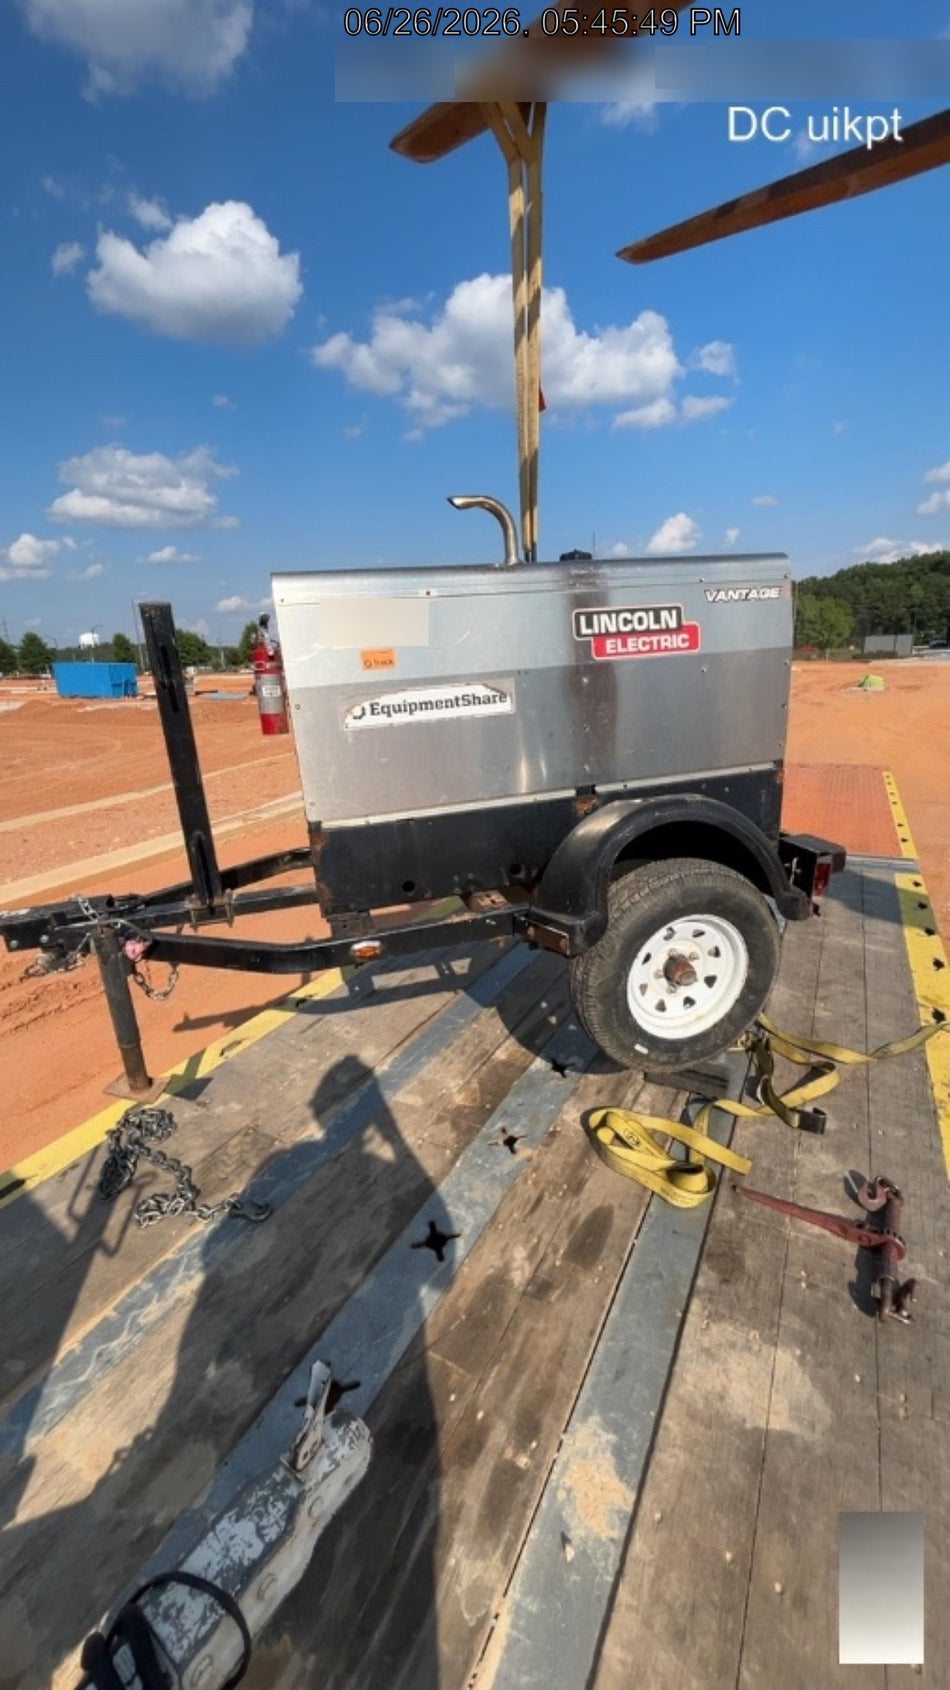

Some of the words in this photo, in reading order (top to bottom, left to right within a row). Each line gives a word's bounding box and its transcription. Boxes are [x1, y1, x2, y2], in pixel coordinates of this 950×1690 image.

[705, 586, 781, 602] VANTAGE
[579, 608, 677, 635] LINCOLN
[605, 633, 690, 654] ELECTRIC
[369, 692, 507, 717] EquipmentShare
